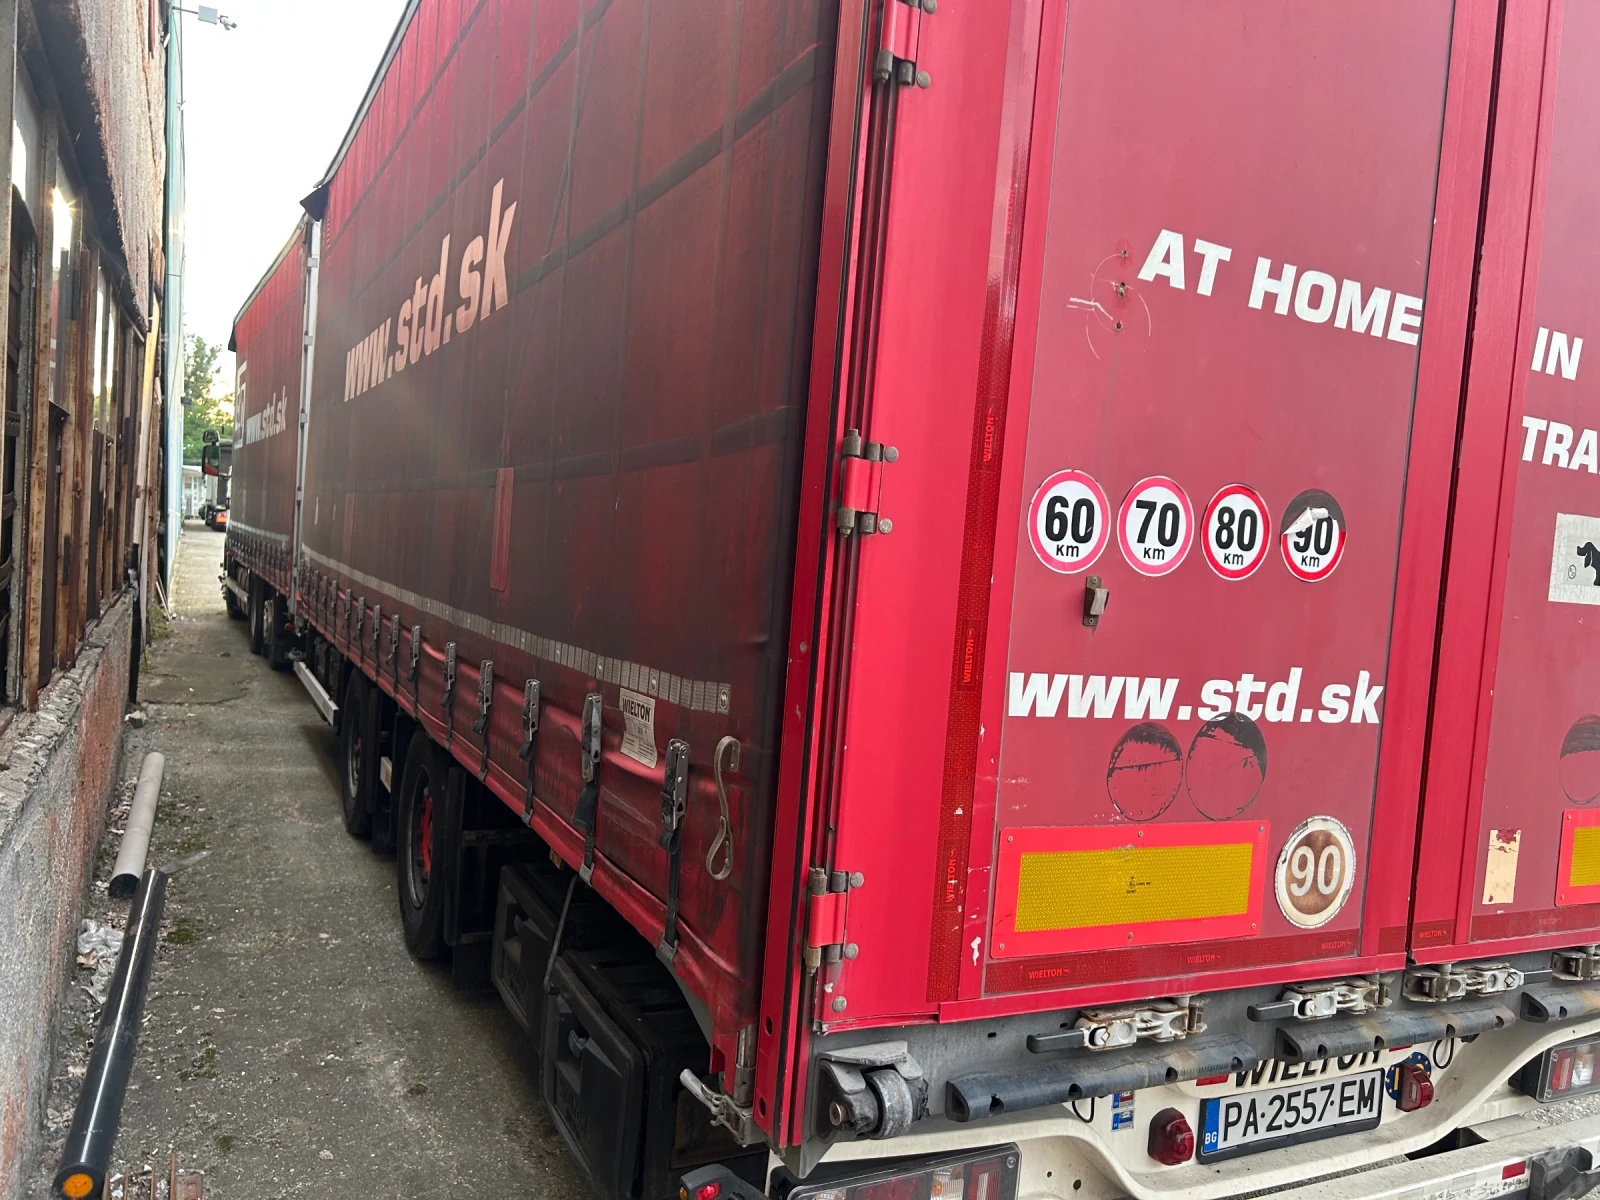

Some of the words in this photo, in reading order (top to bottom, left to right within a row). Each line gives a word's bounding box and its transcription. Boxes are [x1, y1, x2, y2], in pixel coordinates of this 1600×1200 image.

[344, 178, 517, 402] www.std.sk
[1137, 229, 1232, 296] AT
[1248, 256, 1423, 346] HOME
[1531, 326, 1584, 381] IN
[983, 415, 995, 463] WIELTON
[1522, 415, 1600, 474] TRA
[1045, 495, 1095, 544] 60
[1135, 499, 1180, 547] 70
[1215, 506, 1257, 552] 80
[1293, 515, 1334, 556] 90
[963, 638, 975, 683] WIELTON
[622, 697, 651, 723] WIELTON
[1008, 667, 1384, 724] www.std.sk
[945, 854, 956, 903] WIELTON
[1290, 845, 1341, 897] 90
[1187, 953, 1216, 964] WIELTON
[1320, 940, 1346, 950] WIELTON
[1028, 967, 1063, 980] WIELTON
[1204, 1131, 1218, 1145] BG
